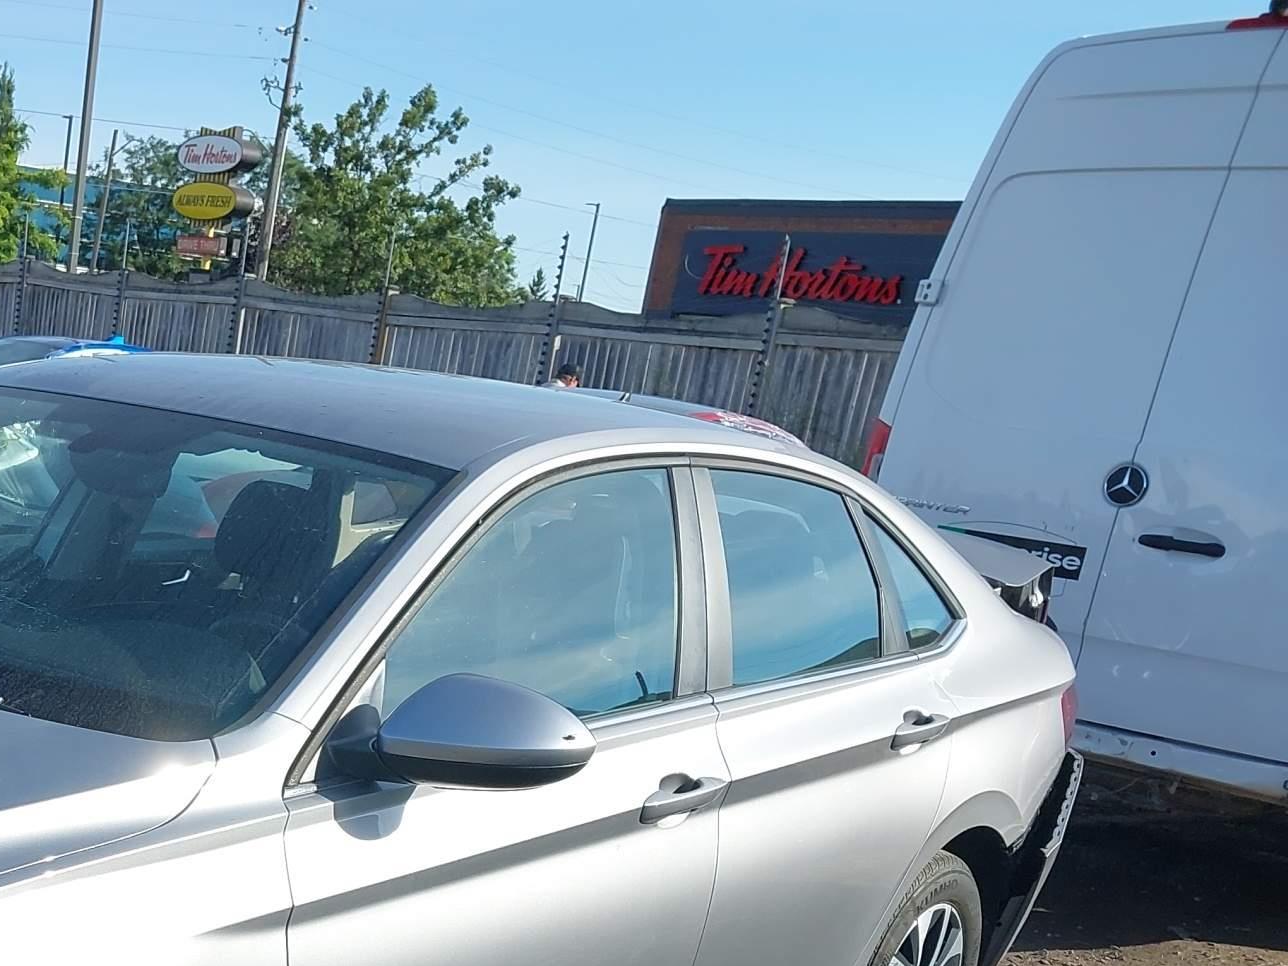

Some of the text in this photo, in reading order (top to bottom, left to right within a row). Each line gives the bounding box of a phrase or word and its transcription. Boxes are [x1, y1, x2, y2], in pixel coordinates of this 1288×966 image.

[183, 143, 237, 165] Tim Hortons
[176, 193, 232, 208] ALWAYS FRESH
[697, 243, 903, 306] Tim Hortons
[895, 495, 971, 517] PRINTER
